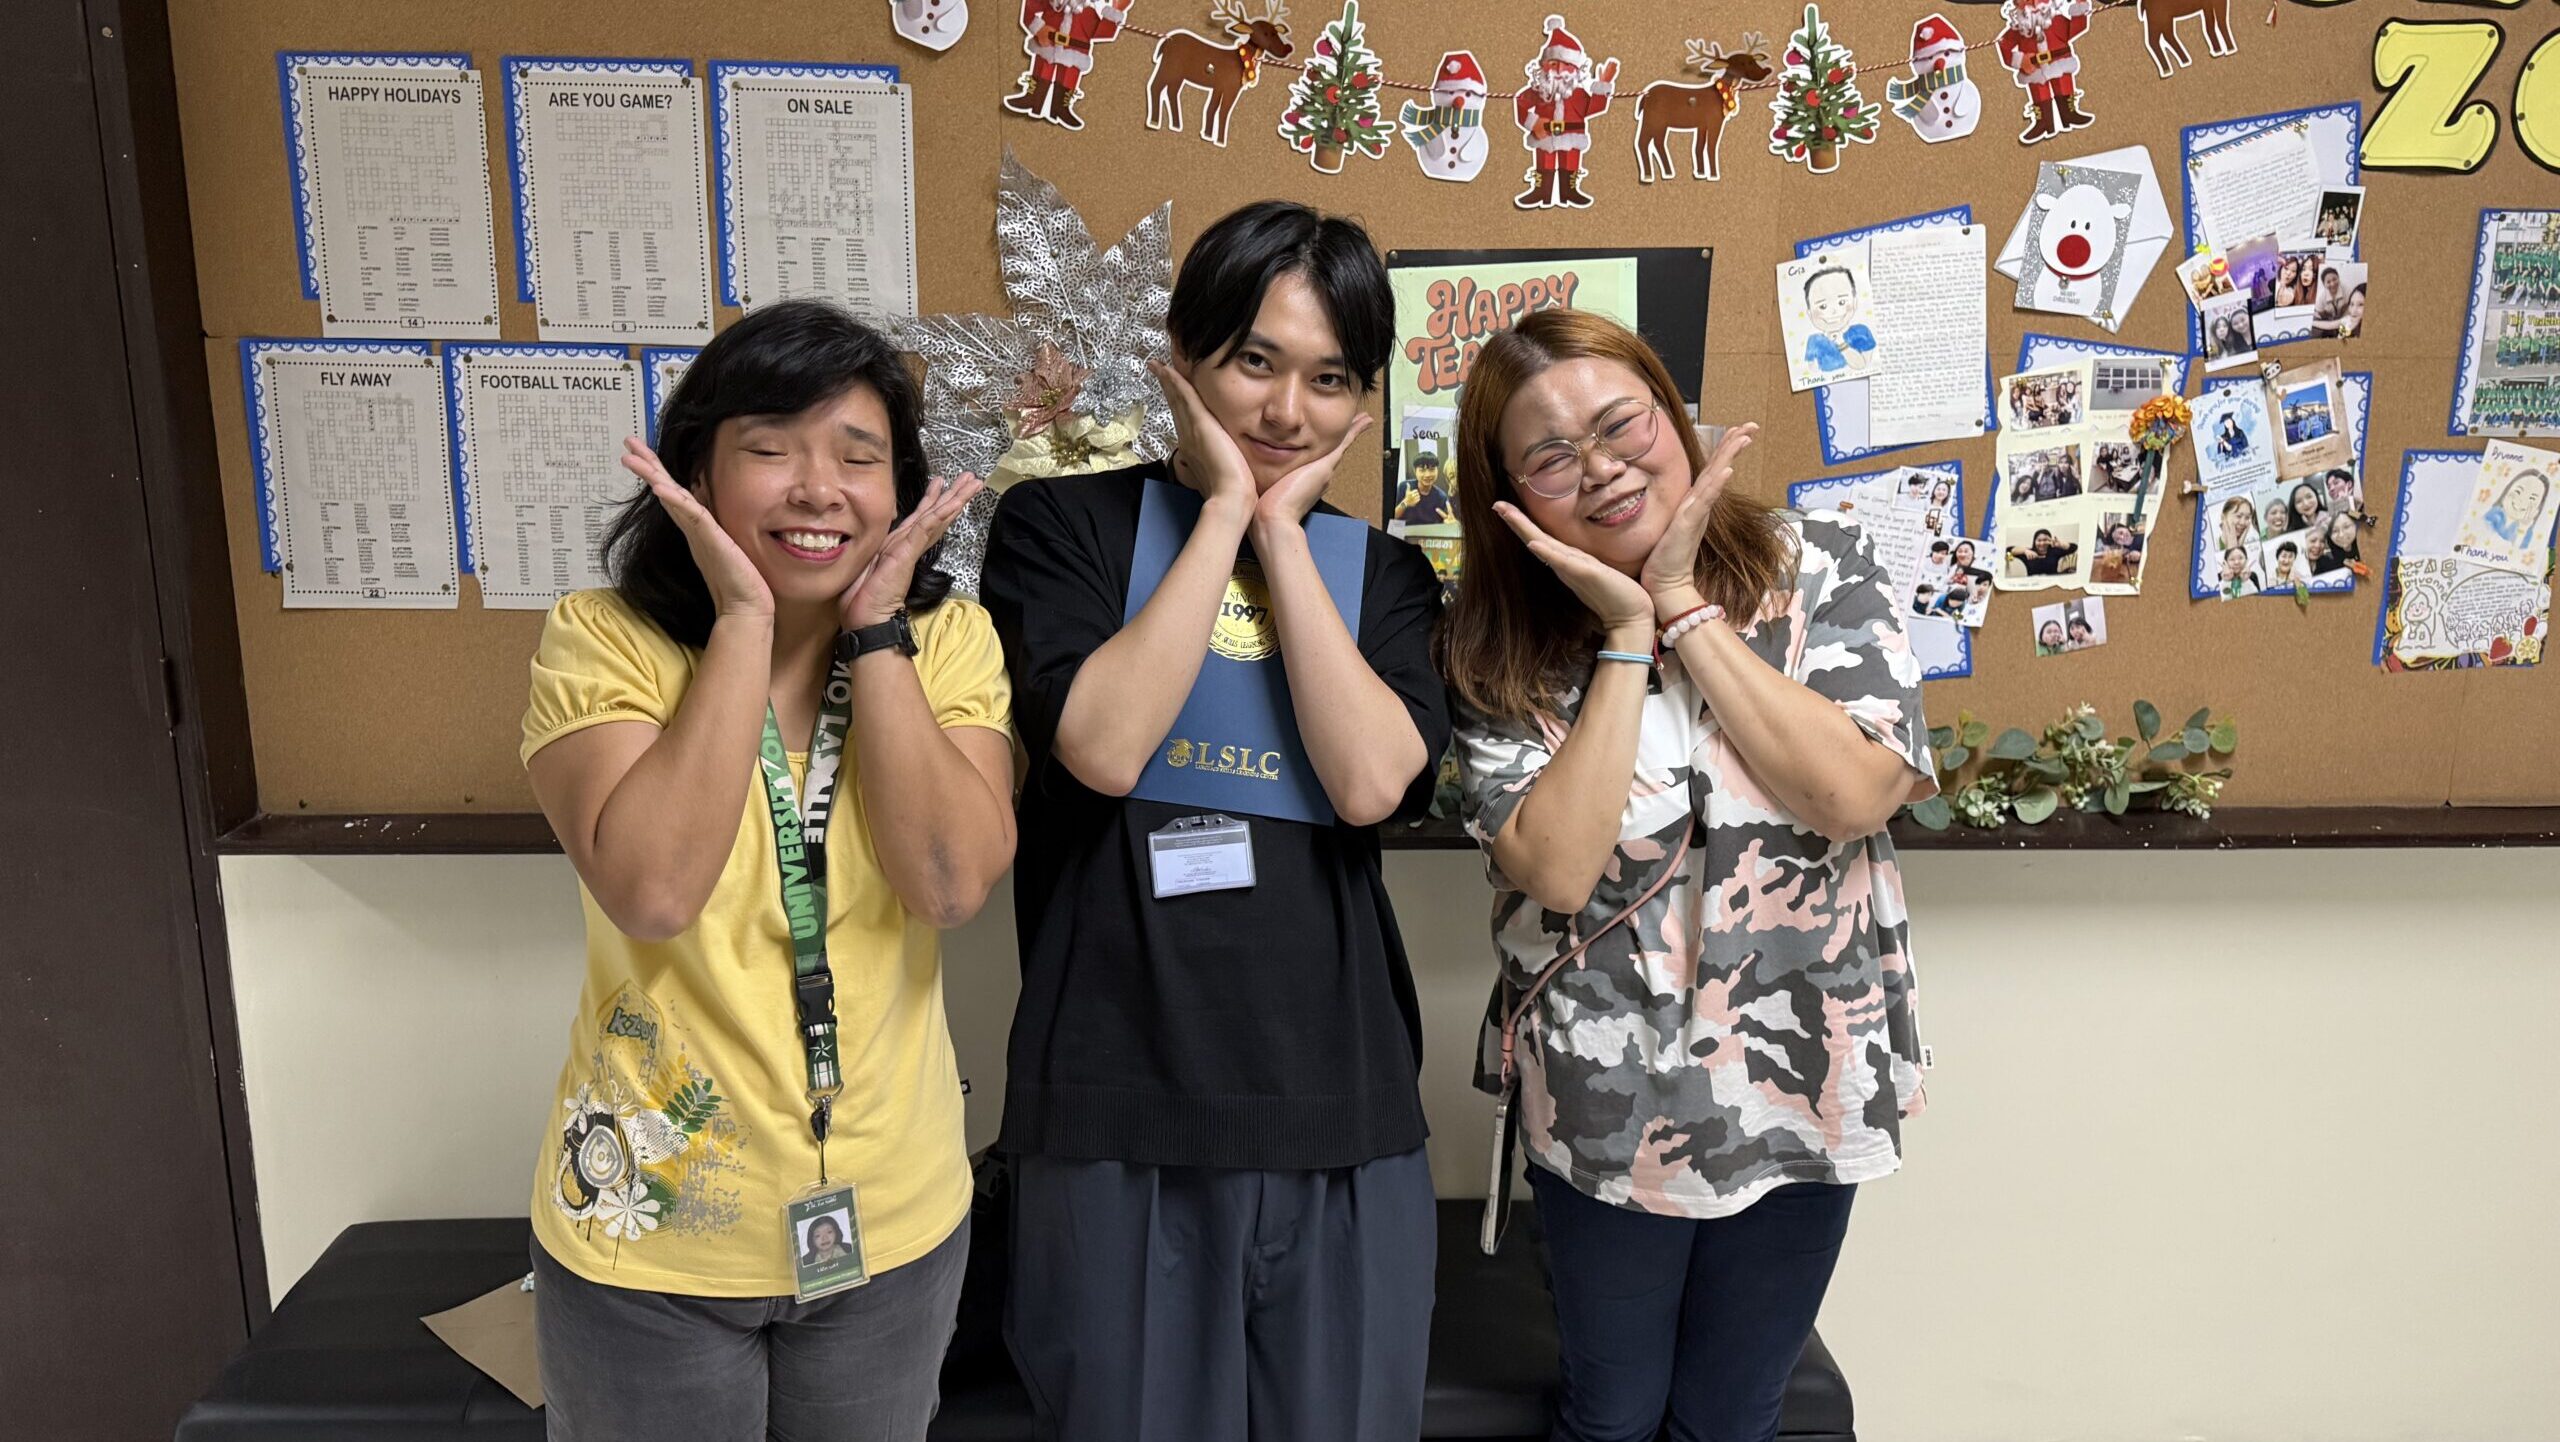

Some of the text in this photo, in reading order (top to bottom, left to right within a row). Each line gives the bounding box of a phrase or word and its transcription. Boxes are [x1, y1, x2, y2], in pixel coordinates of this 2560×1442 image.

[328, 86, 462, 104] HAPPY HOLIDAYS
[549, 92, 672, 109] ARE YOU GAME?
[787, 98, 853, 115] ON SALE
[1427, 271, 1579, 341] HAPPY
[407, 318, 418, 327] 14
[321, 372, 392, 388] FLY AWAY
[480, 374, 622, 391] FOOTBALL TACKLE
[1412, 425, 1440, 439] Sean
[2460, 544, 2509, 563] Thank you
[369, 588, 379, 597] 22
[1221, 602, 1268, 625] 1997
[1195, 742, 1281, 775] LSLC
[768, 769, 819, 940] UNIVERSITY
